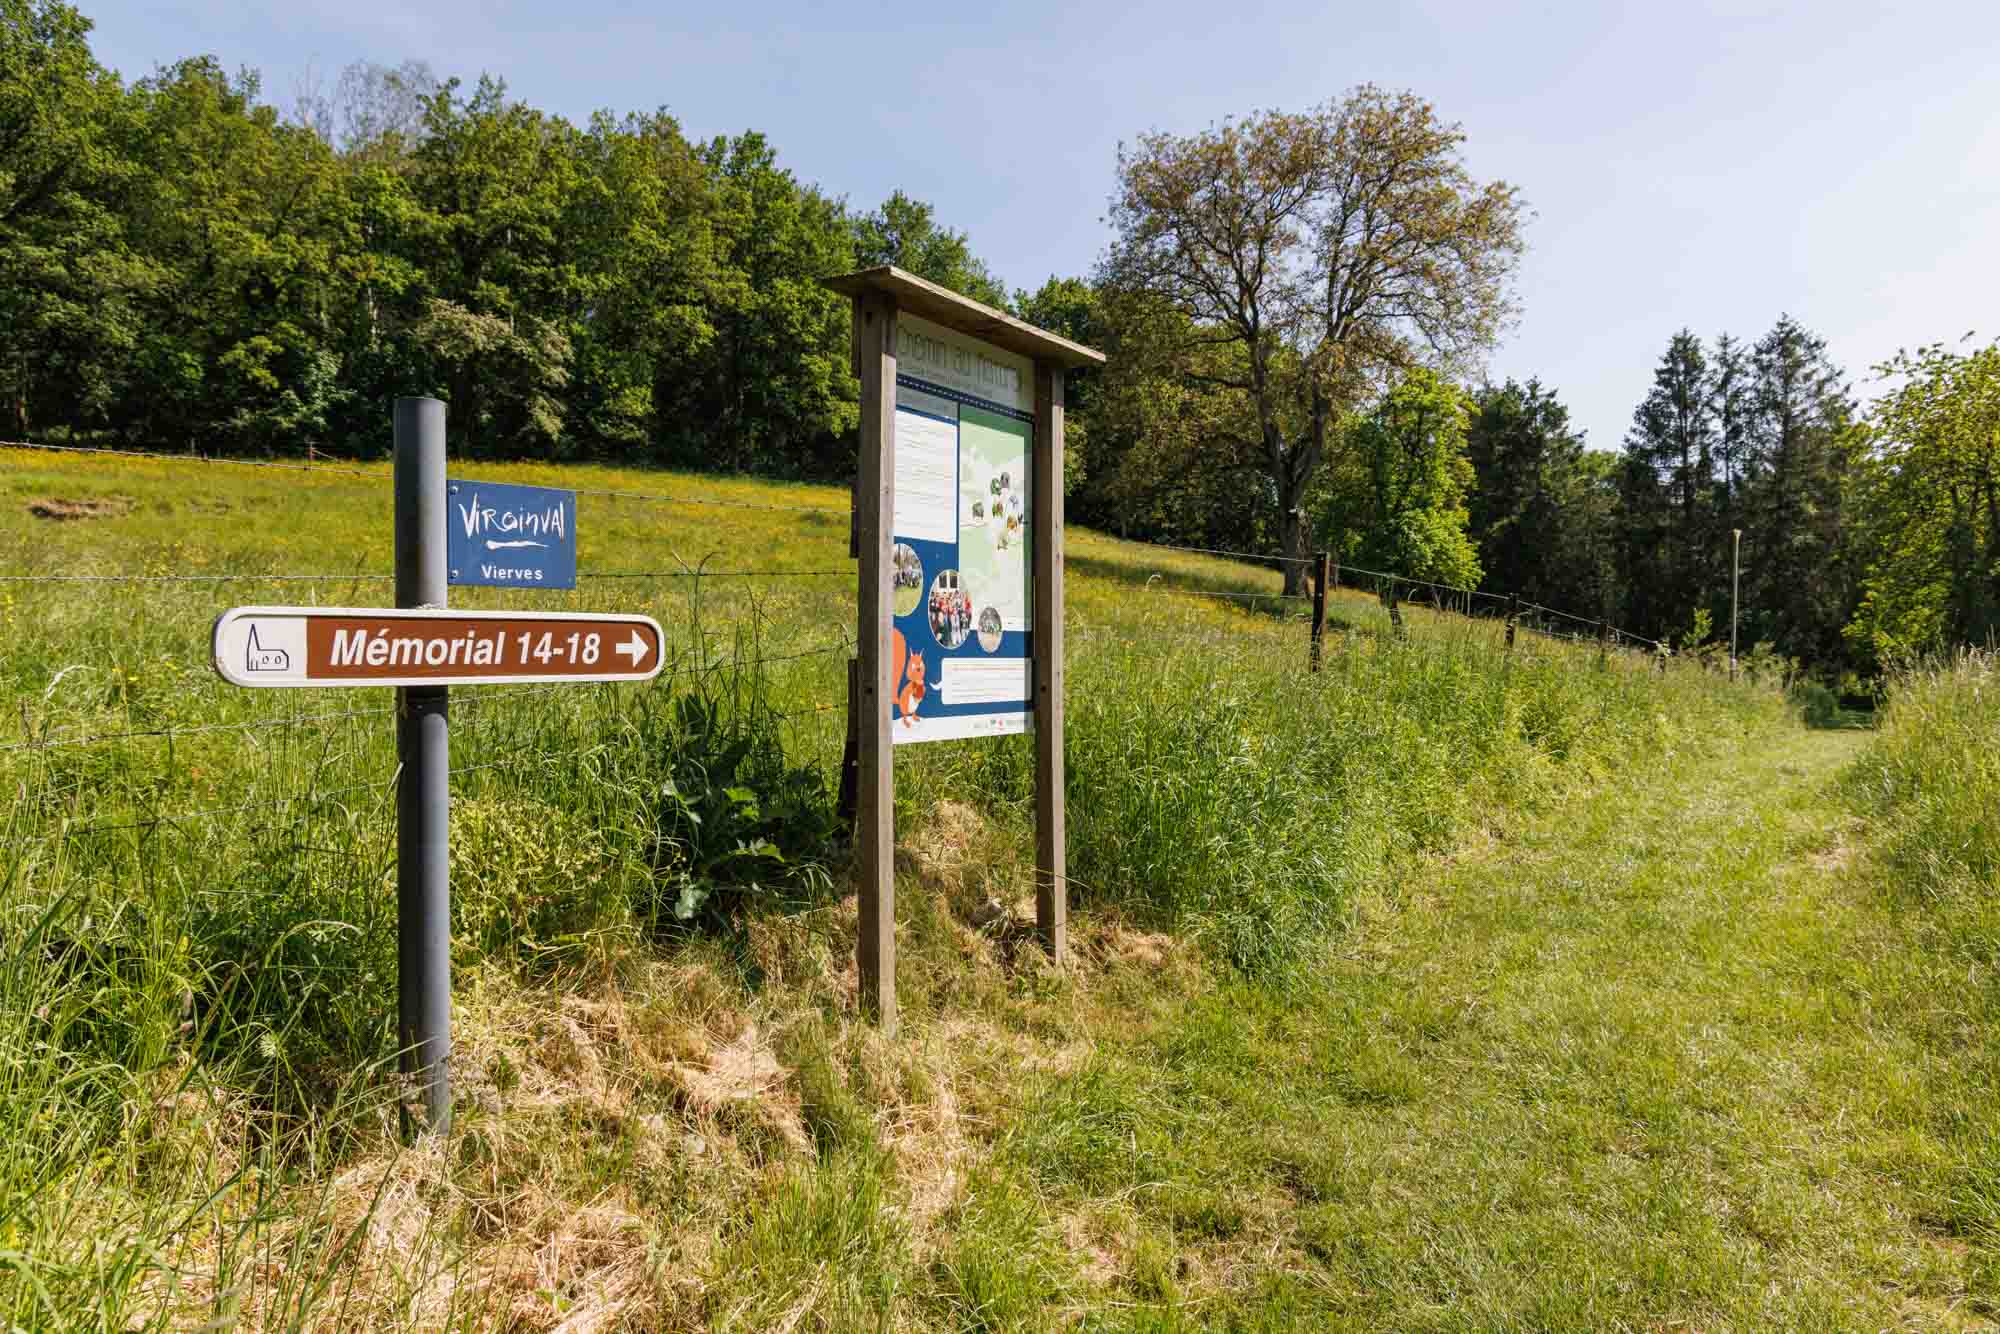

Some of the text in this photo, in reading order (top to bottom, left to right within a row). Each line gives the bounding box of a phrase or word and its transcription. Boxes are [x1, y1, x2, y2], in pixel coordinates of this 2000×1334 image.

[481, 564, 543, 580] Vierves
[329, 627, 601, 667] Mémorial 14-18
